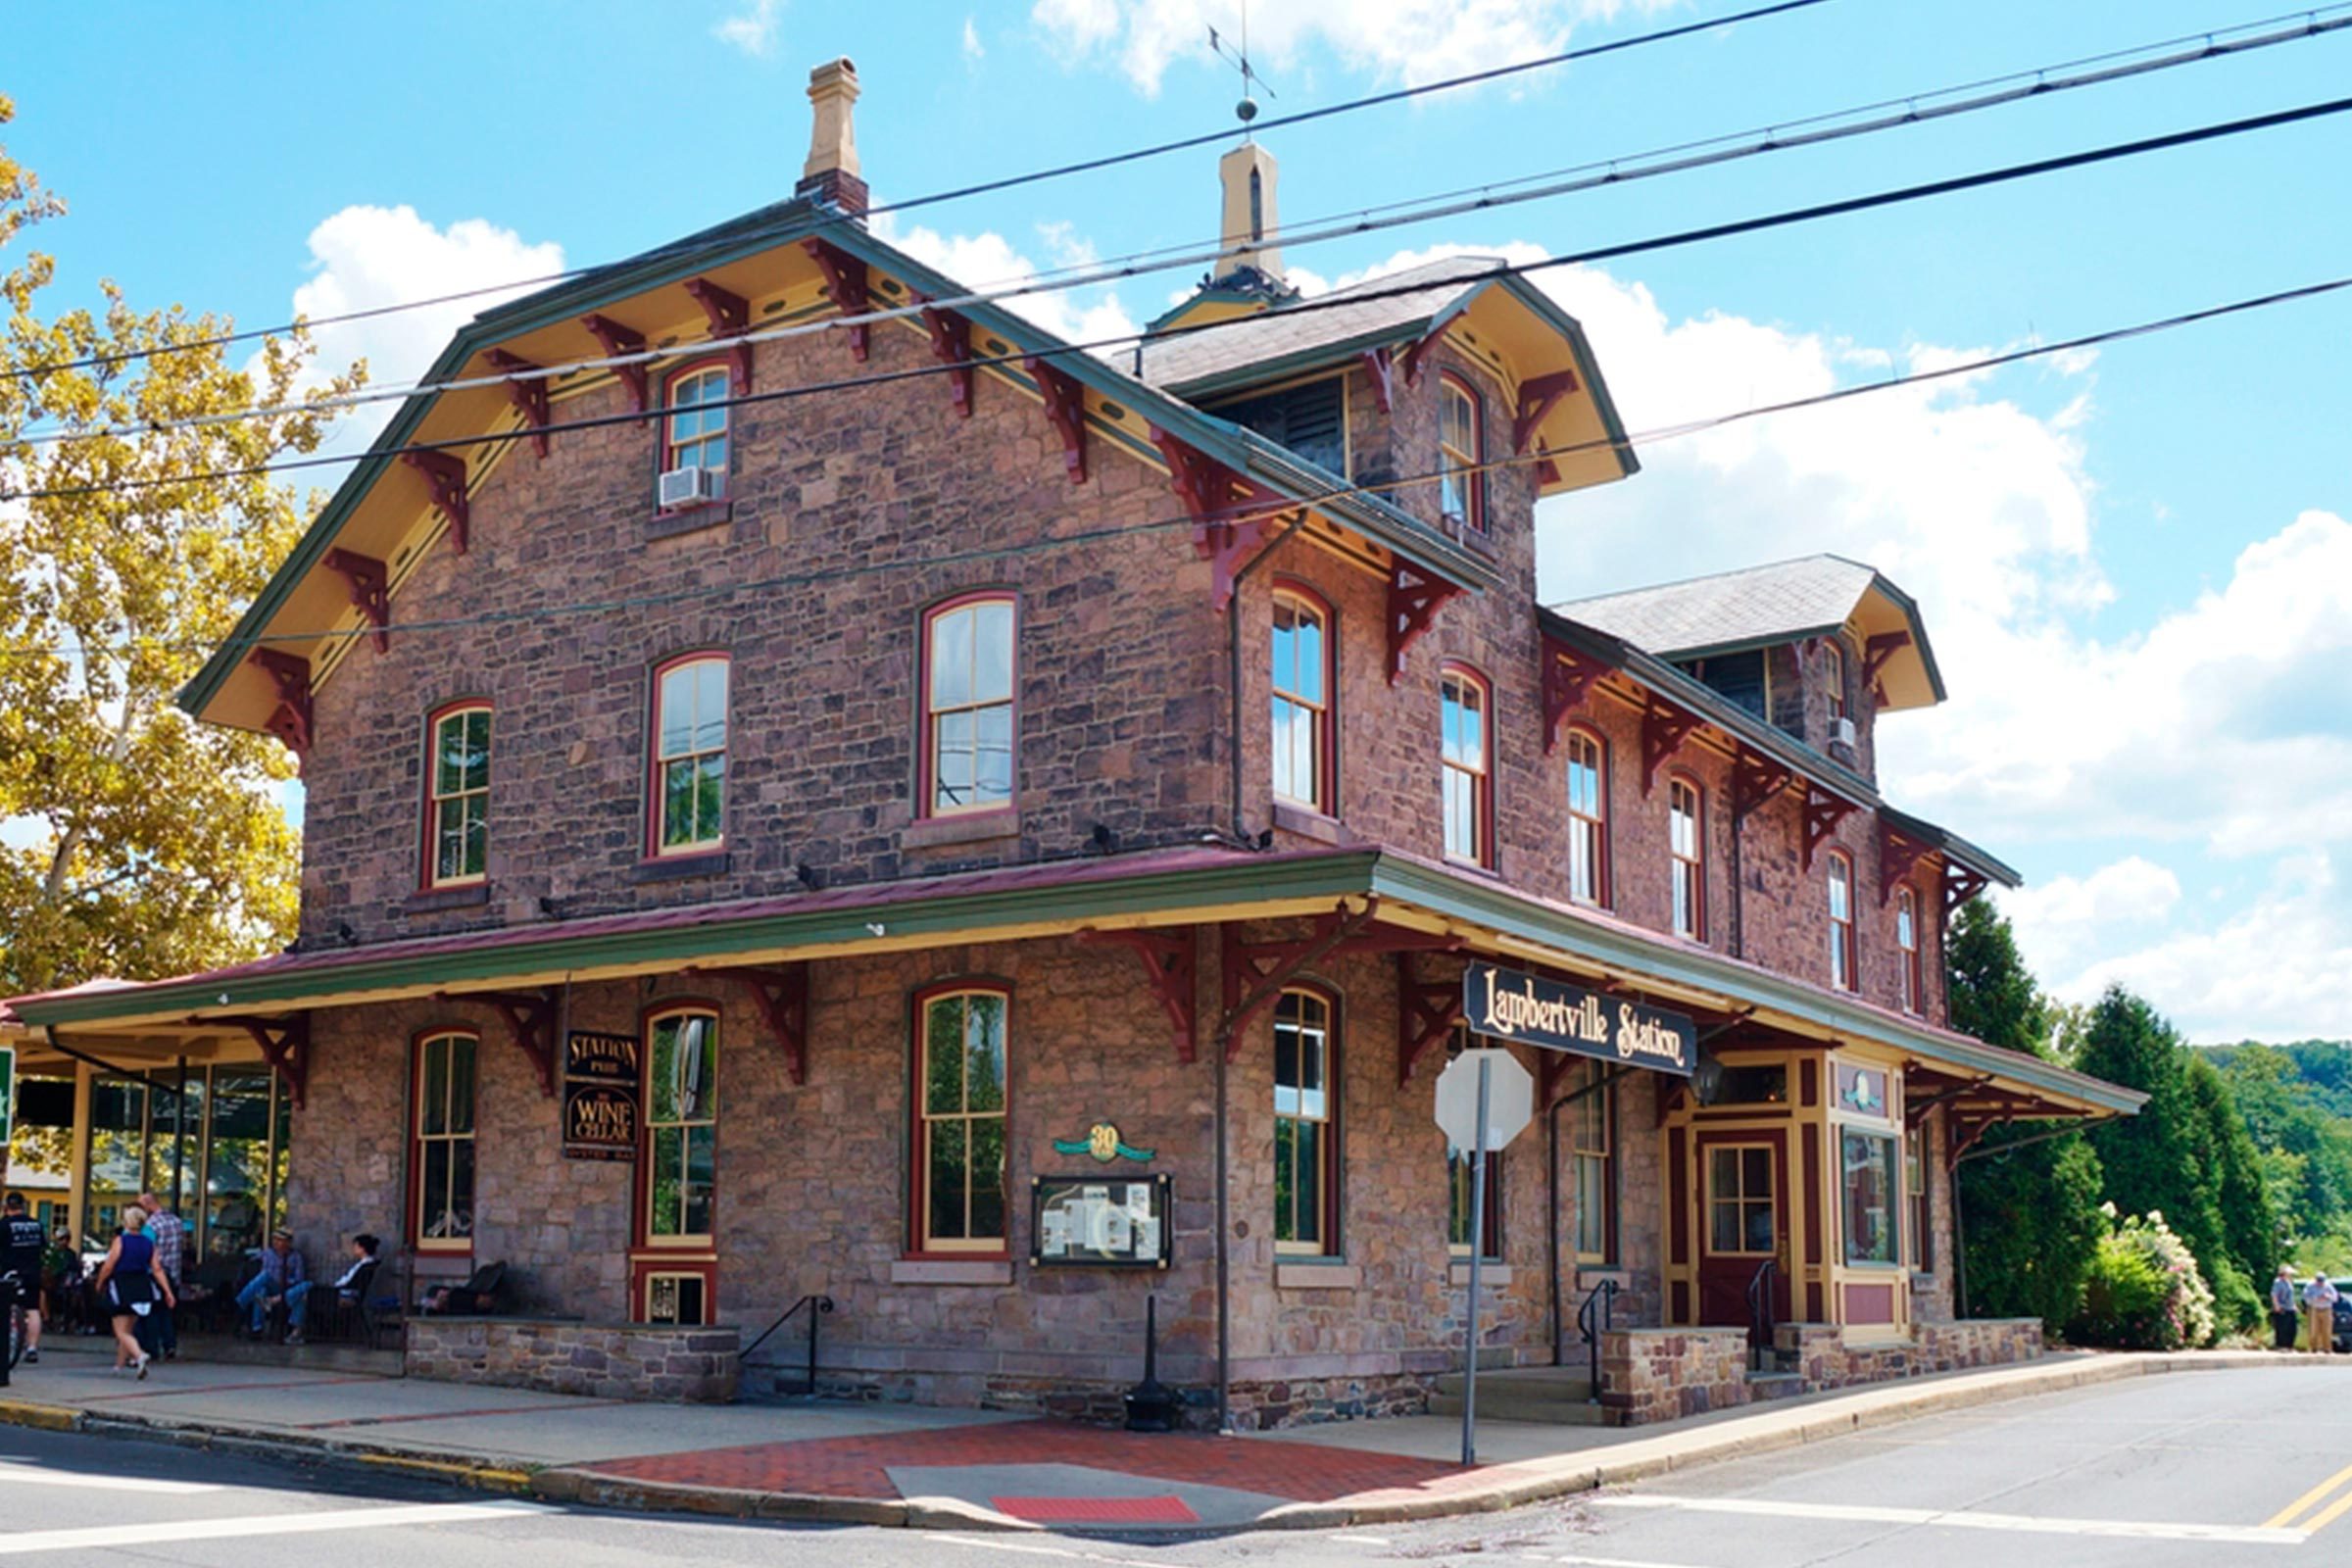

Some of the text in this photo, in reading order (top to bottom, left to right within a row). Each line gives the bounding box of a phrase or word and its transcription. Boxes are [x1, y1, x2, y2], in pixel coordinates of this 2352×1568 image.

[1484, 968, 1685, 1067] Lambertville Station
[570, 1035, 636, 1071] STATION
[576, 1099, 631, 1124] WINE
[1091, 1124, 1118, 1149] 30
